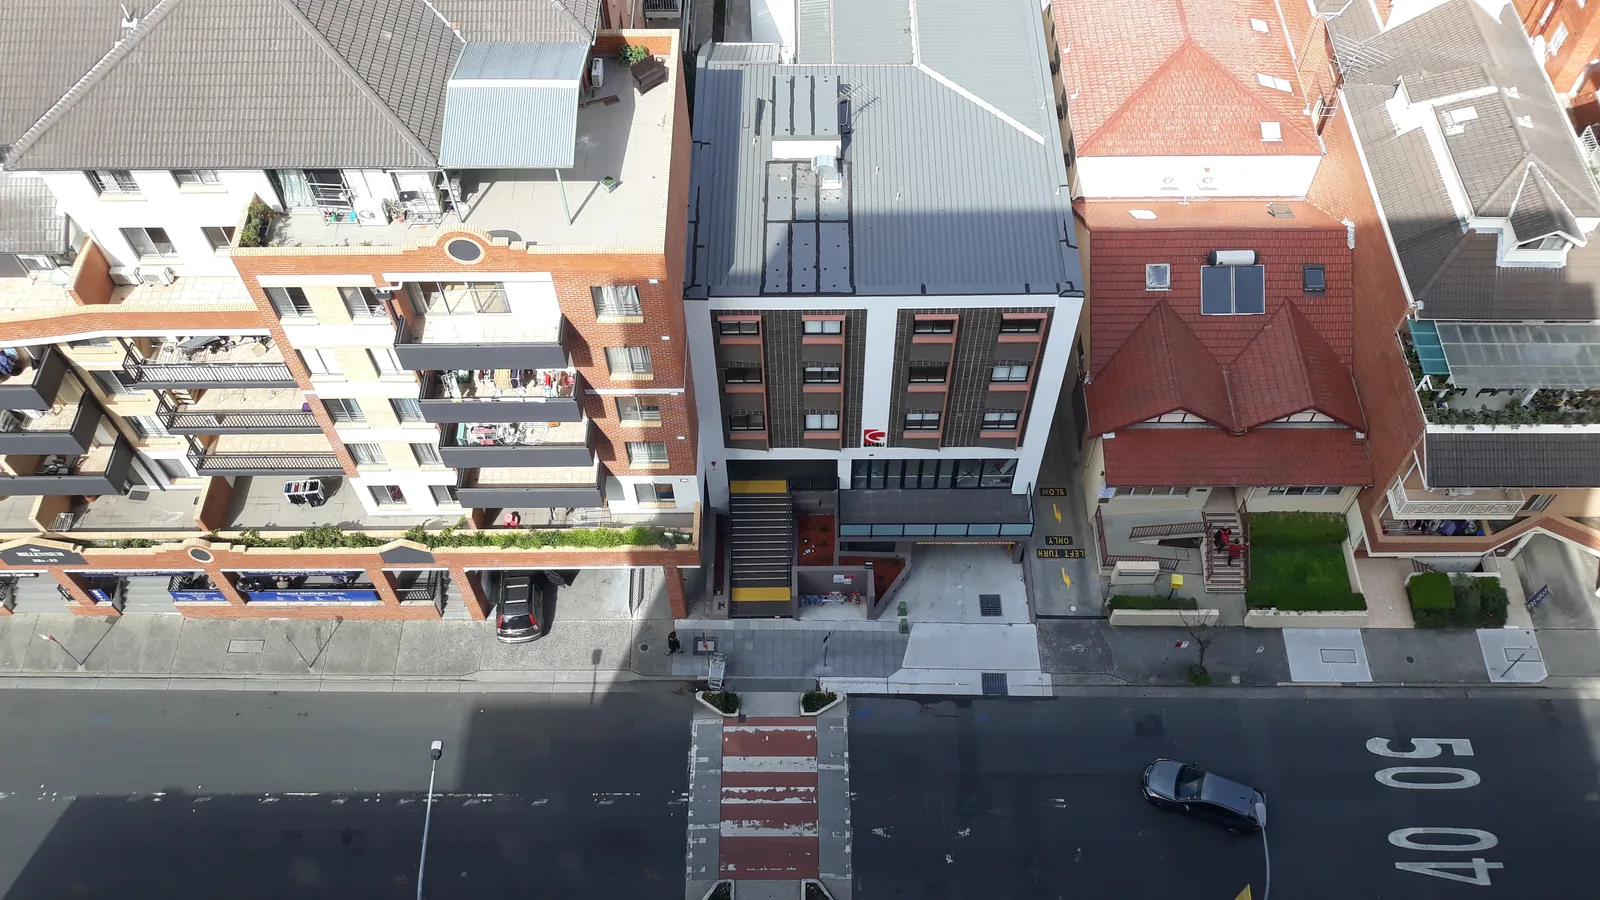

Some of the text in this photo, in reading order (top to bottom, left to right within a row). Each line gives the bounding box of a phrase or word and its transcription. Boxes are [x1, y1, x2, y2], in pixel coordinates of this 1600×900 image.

[1042, 488, 1065, 496] SLOW
[1048, 537, 1069, 545] ONLY
[1037, 550, 1085, 558] LEFT TURN
[1366, 736, 1481, 790] 50
[1387, 826, 1504, 886] 40
